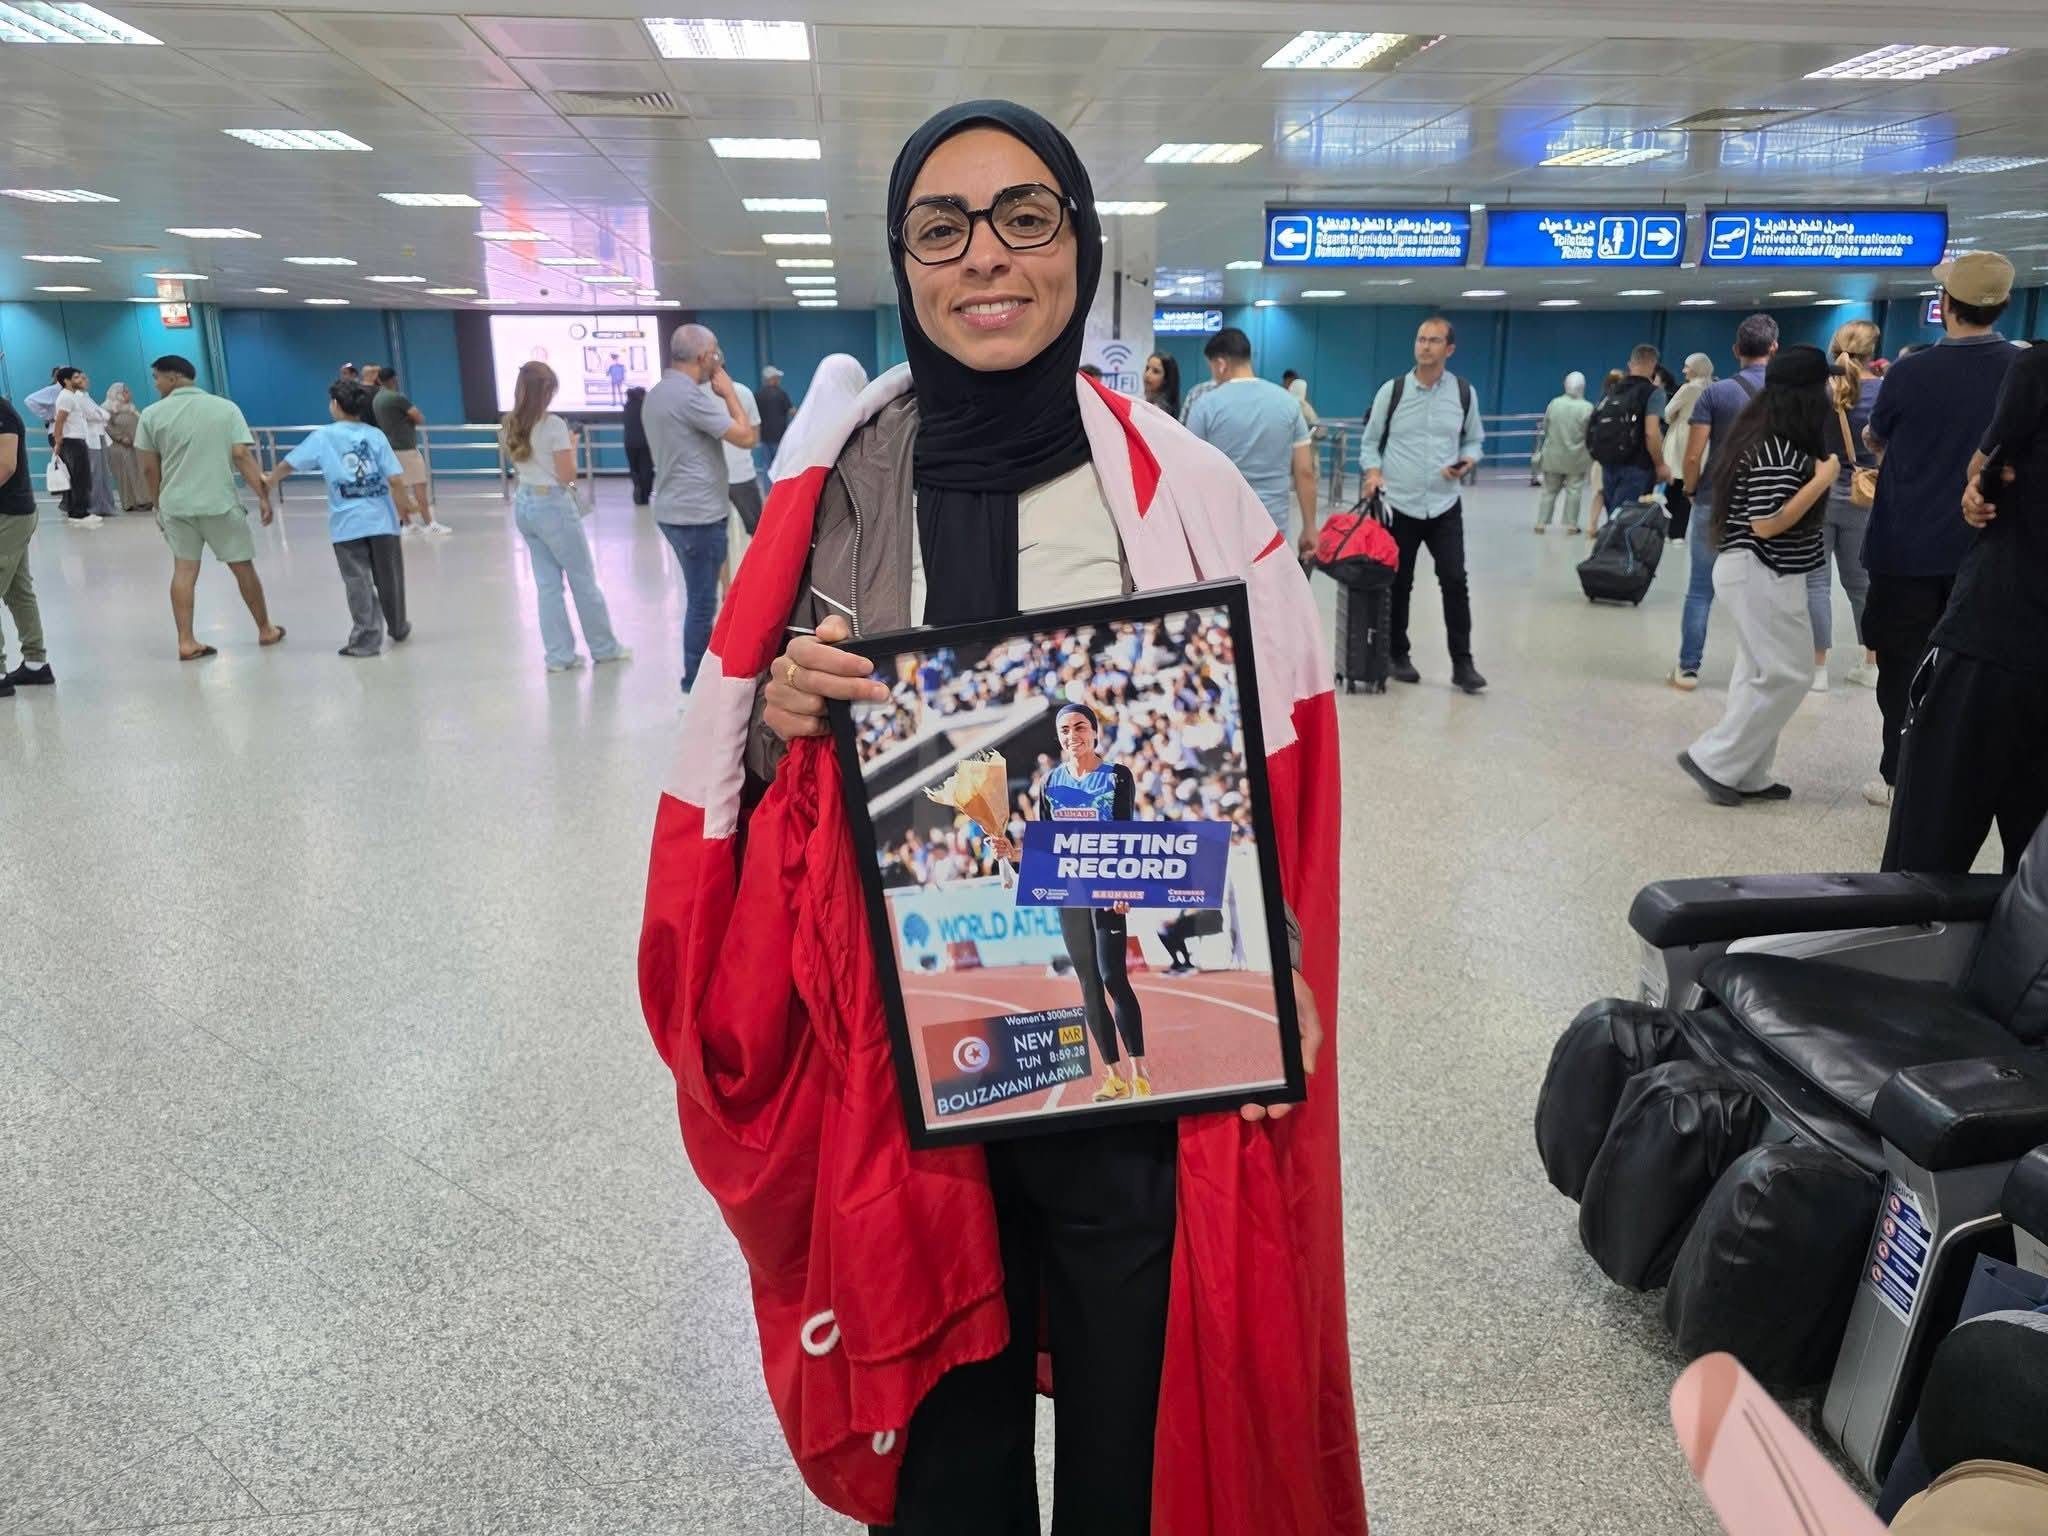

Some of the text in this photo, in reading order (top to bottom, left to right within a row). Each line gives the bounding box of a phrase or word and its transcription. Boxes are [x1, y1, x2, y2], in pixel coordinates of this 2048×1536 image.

[1565, 219, 1596, 234] دورة
[1824, 220, 1854, 234] وصول
[1418, 234, 1461, 245] nationales
[1553, 233, 1595, 247] Toilettes
[1753, 232, 1913, 246] Arrivées lignes internationales
[1561, 246, 1593, 259] Toilets
[1751, 245, 1904, 258] International flights arrivals
[1053, 833, 1198, 855] MEETING
[1057, 857, 1187, 879] RECORD
[1168, 895, 1205, 903] GALAN
[937, 910, 1008, 941] WORLD
[1005, 1007, 1084, 1026] Women's 3000mSC
[1013, 1027, 1081, 1053] NEW MR
[1017, 1054, 1041, 1071] TUN
[937, 1064, 1084, 1115] BOUZAYANI MARWA
